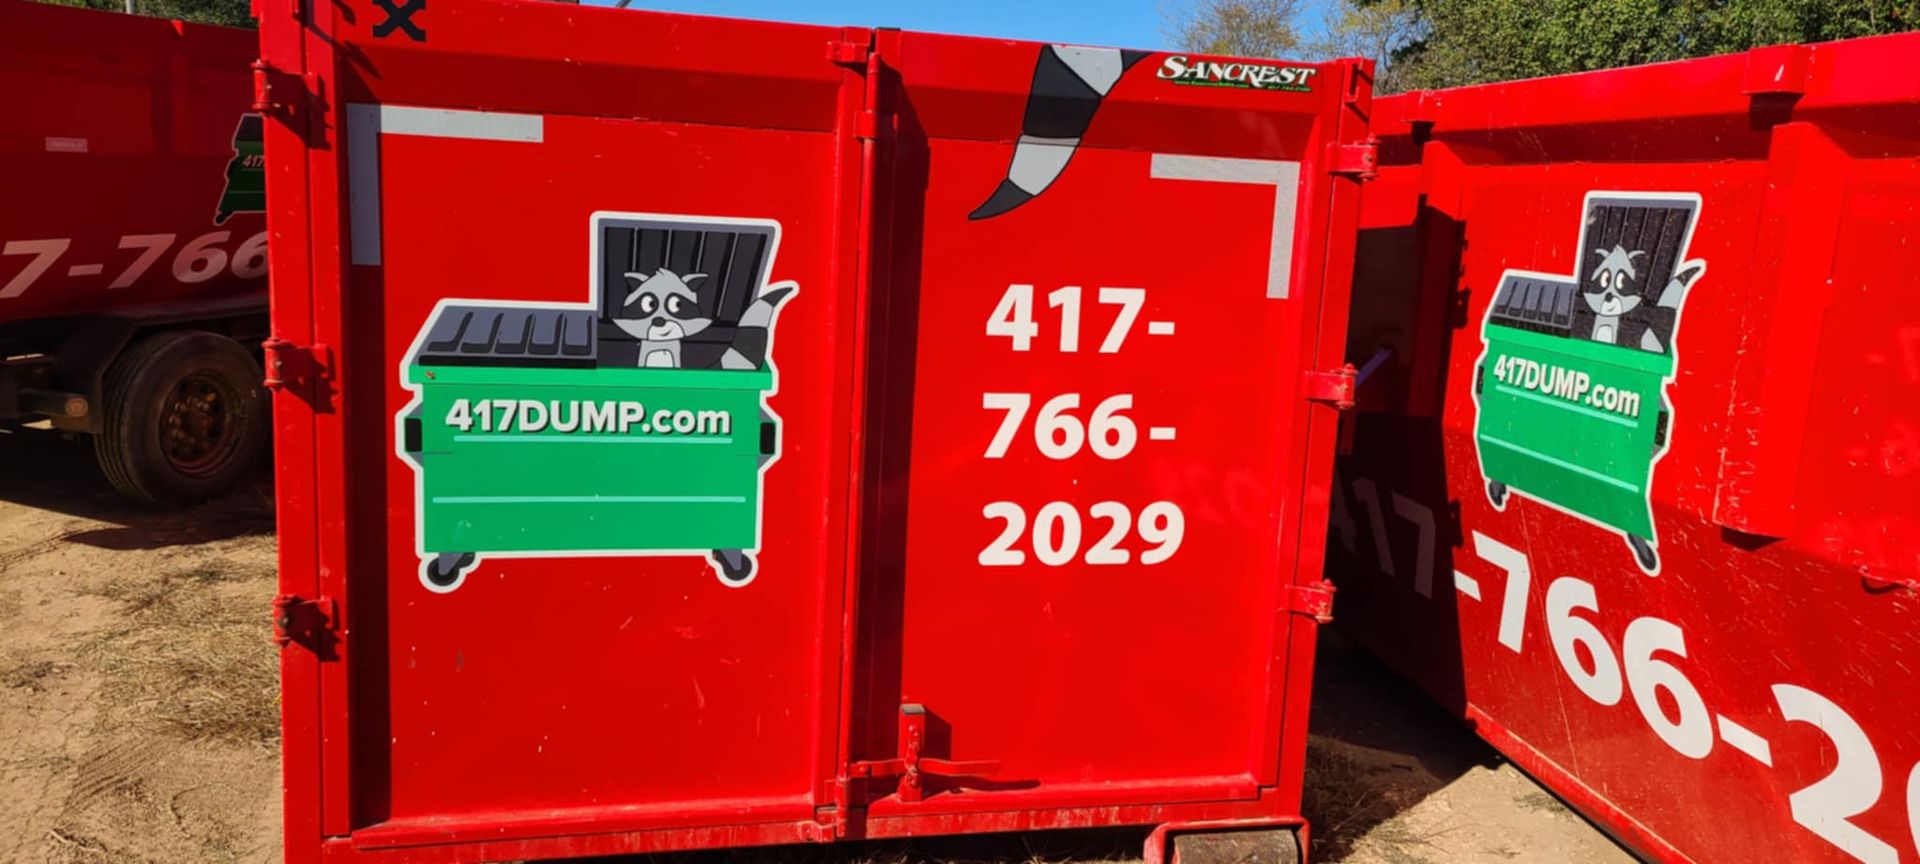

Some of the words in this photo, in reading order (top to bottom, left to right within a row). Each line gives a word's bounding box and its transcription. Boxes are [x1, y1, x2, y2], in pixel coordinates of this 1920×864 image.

[1156, 55, 1316, 88] SANCREST
[986, 284, 1175, 353] 417-
[445, 398, 732, 434] 417DUMP.com
[1494, 354, 1640, 418] 417DUMP.com
[982, 392, 1176, 460] 766-
[978, 501, 1185, 566] 2029
